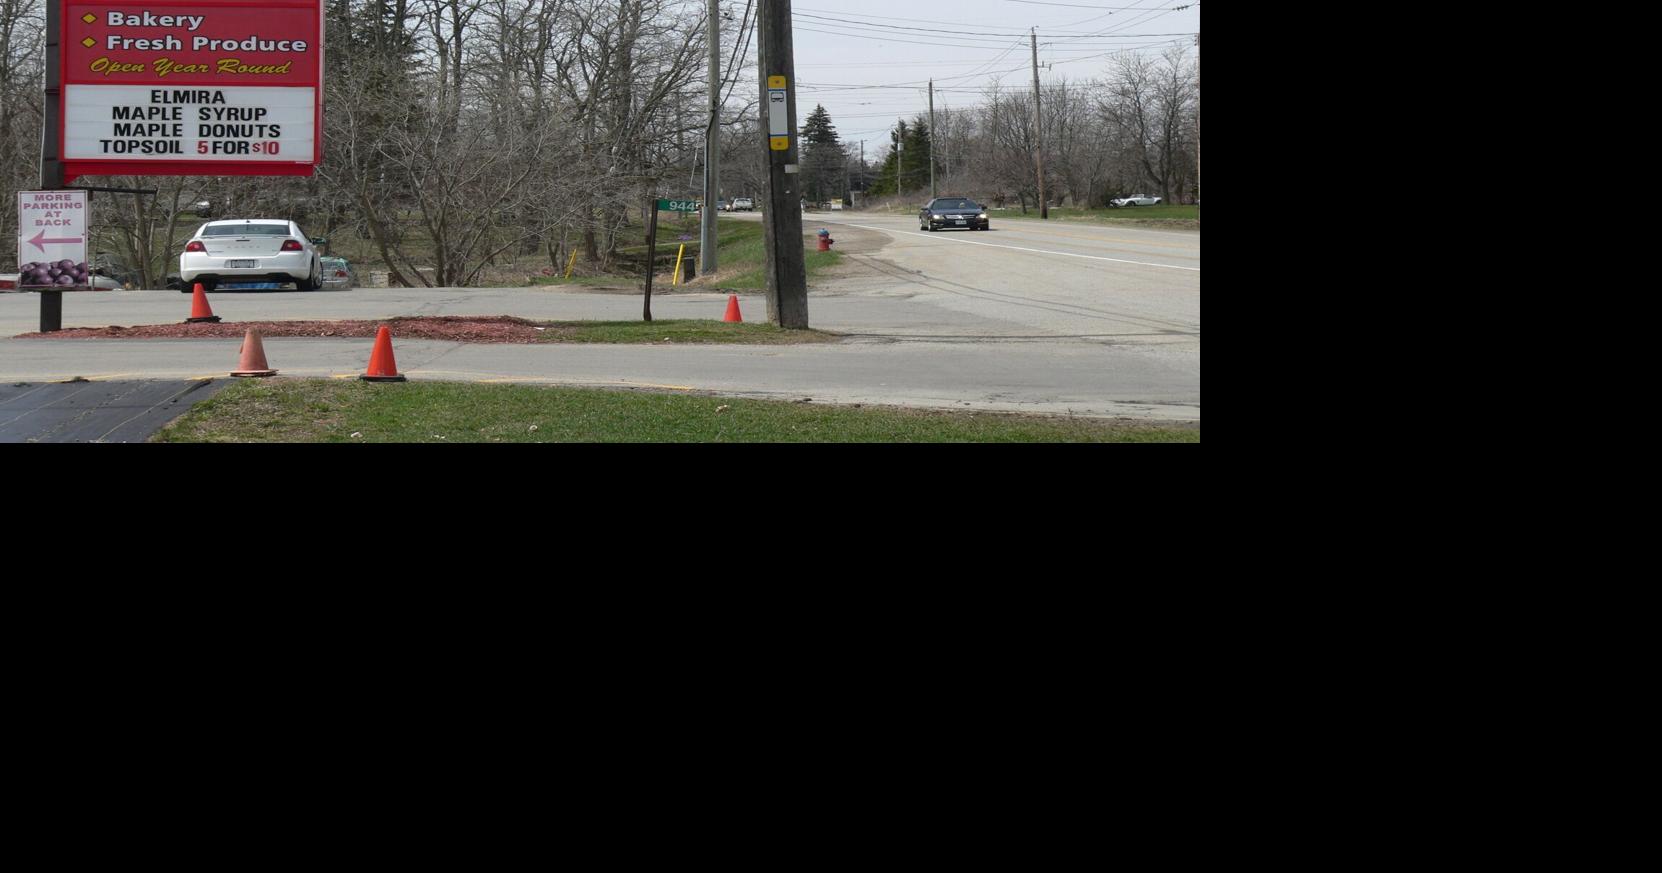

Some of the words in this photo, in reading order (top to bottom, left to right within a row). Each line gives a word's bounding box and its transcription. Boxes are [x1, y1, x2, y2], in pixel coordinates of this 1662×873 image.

[107, 11, 204, 31] Bakery
[107, 35, 182, 51] Fresh
[192, 36, 308, 52] Produce
[89, 57, 146, 75] Open
[152, 57, 209, 76] Year
[216, 58, 292, 75] Round
[151, 90, 226, 104] ELMIRA
[112, 106, 183, 121] MAPLE
[198, 107, 267, 121] SYRUP
[113, 123, 183, 137] MAPLE
[198, 124, 281, 138] DONUTS
[100, 139, 184, 154] TOPSOIL
[197, 140, 209, 154] 5
[212, 141, 249, 155] FOR
